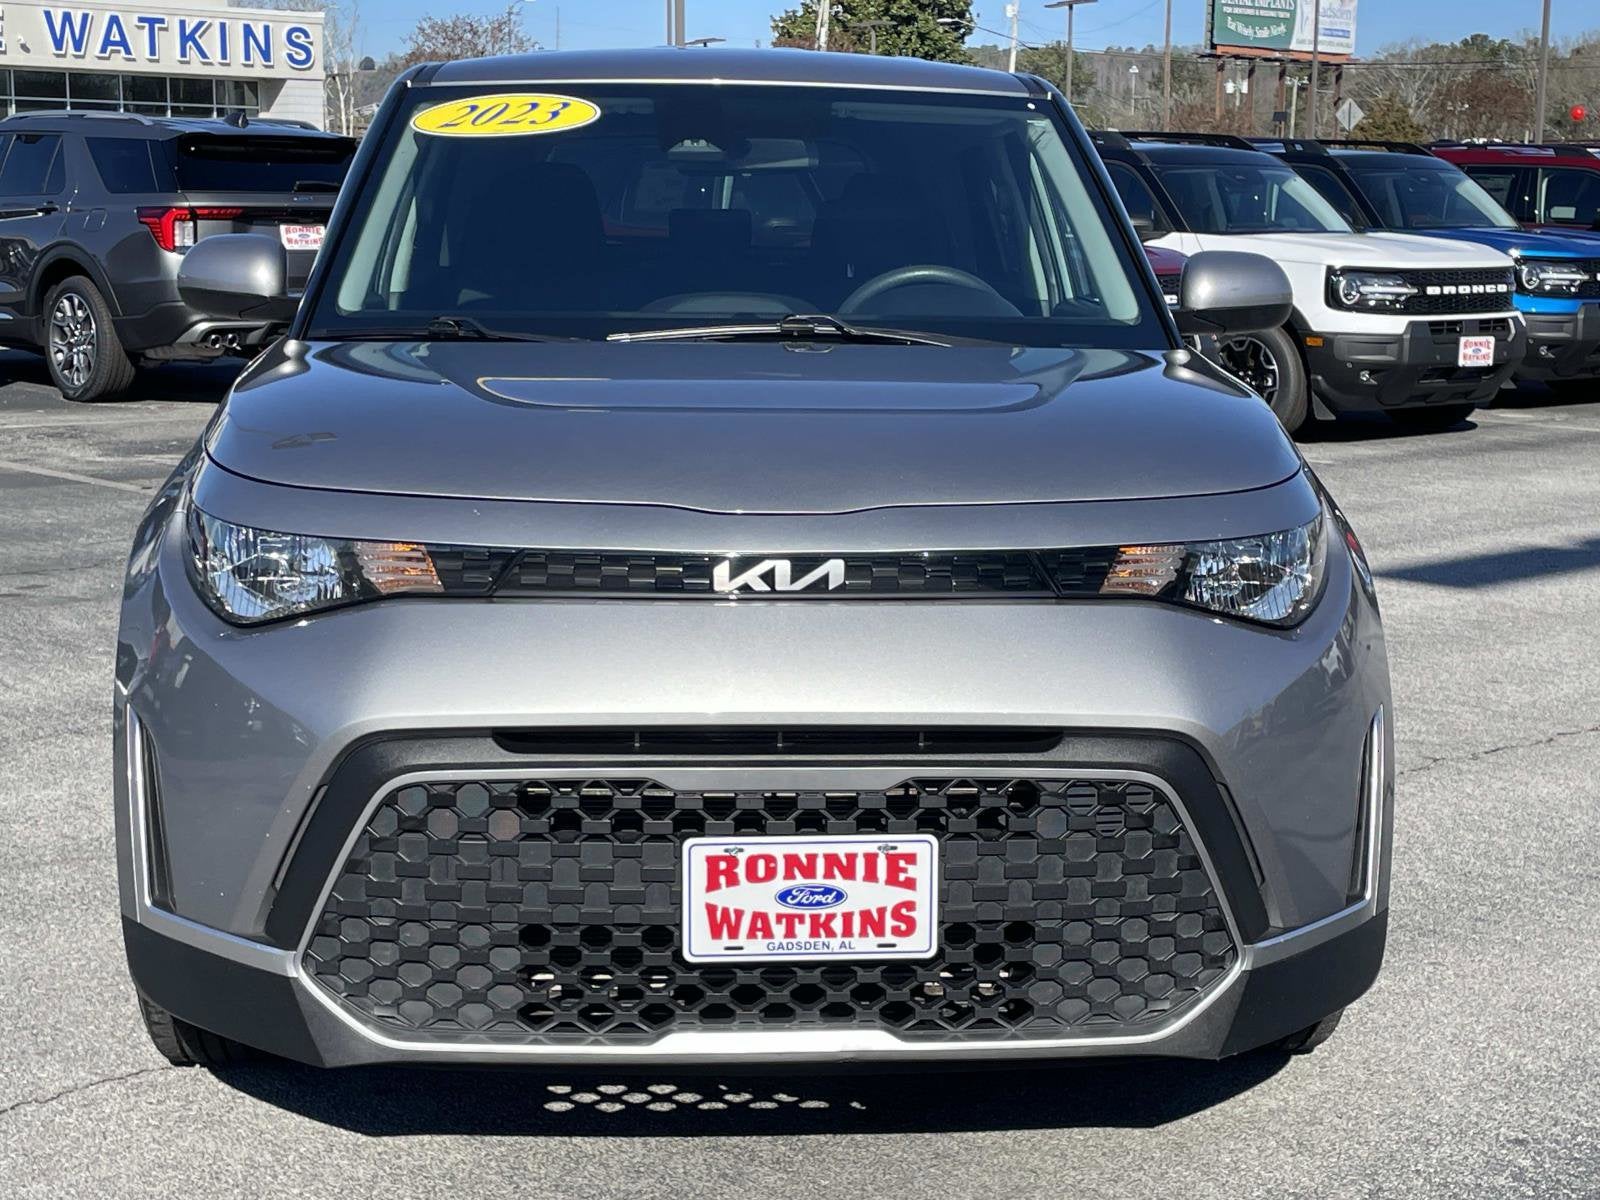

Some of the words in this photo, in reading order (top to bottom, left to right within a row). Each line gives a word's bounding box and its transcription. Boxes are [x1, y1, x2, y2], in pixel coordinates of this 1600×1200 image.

[43, 9, 314, 68] WATKINS
[437, 102, 571, 129] 2023
[285, 226, 322, 235] RONNIE
[1426, 284, 1508, 295] BRONCO
[1463, 339, 1491, 350] RONNIE
[713, 558, 845, 591] KIA
[705, 852, 918, 893] RONNIE
[786, 887, 837, 905] Ford
[705, 900, 918, 940] WATKINS
[766, 941, 835, 952] GADSDEN,
[839, 940, 856, 950] AL
